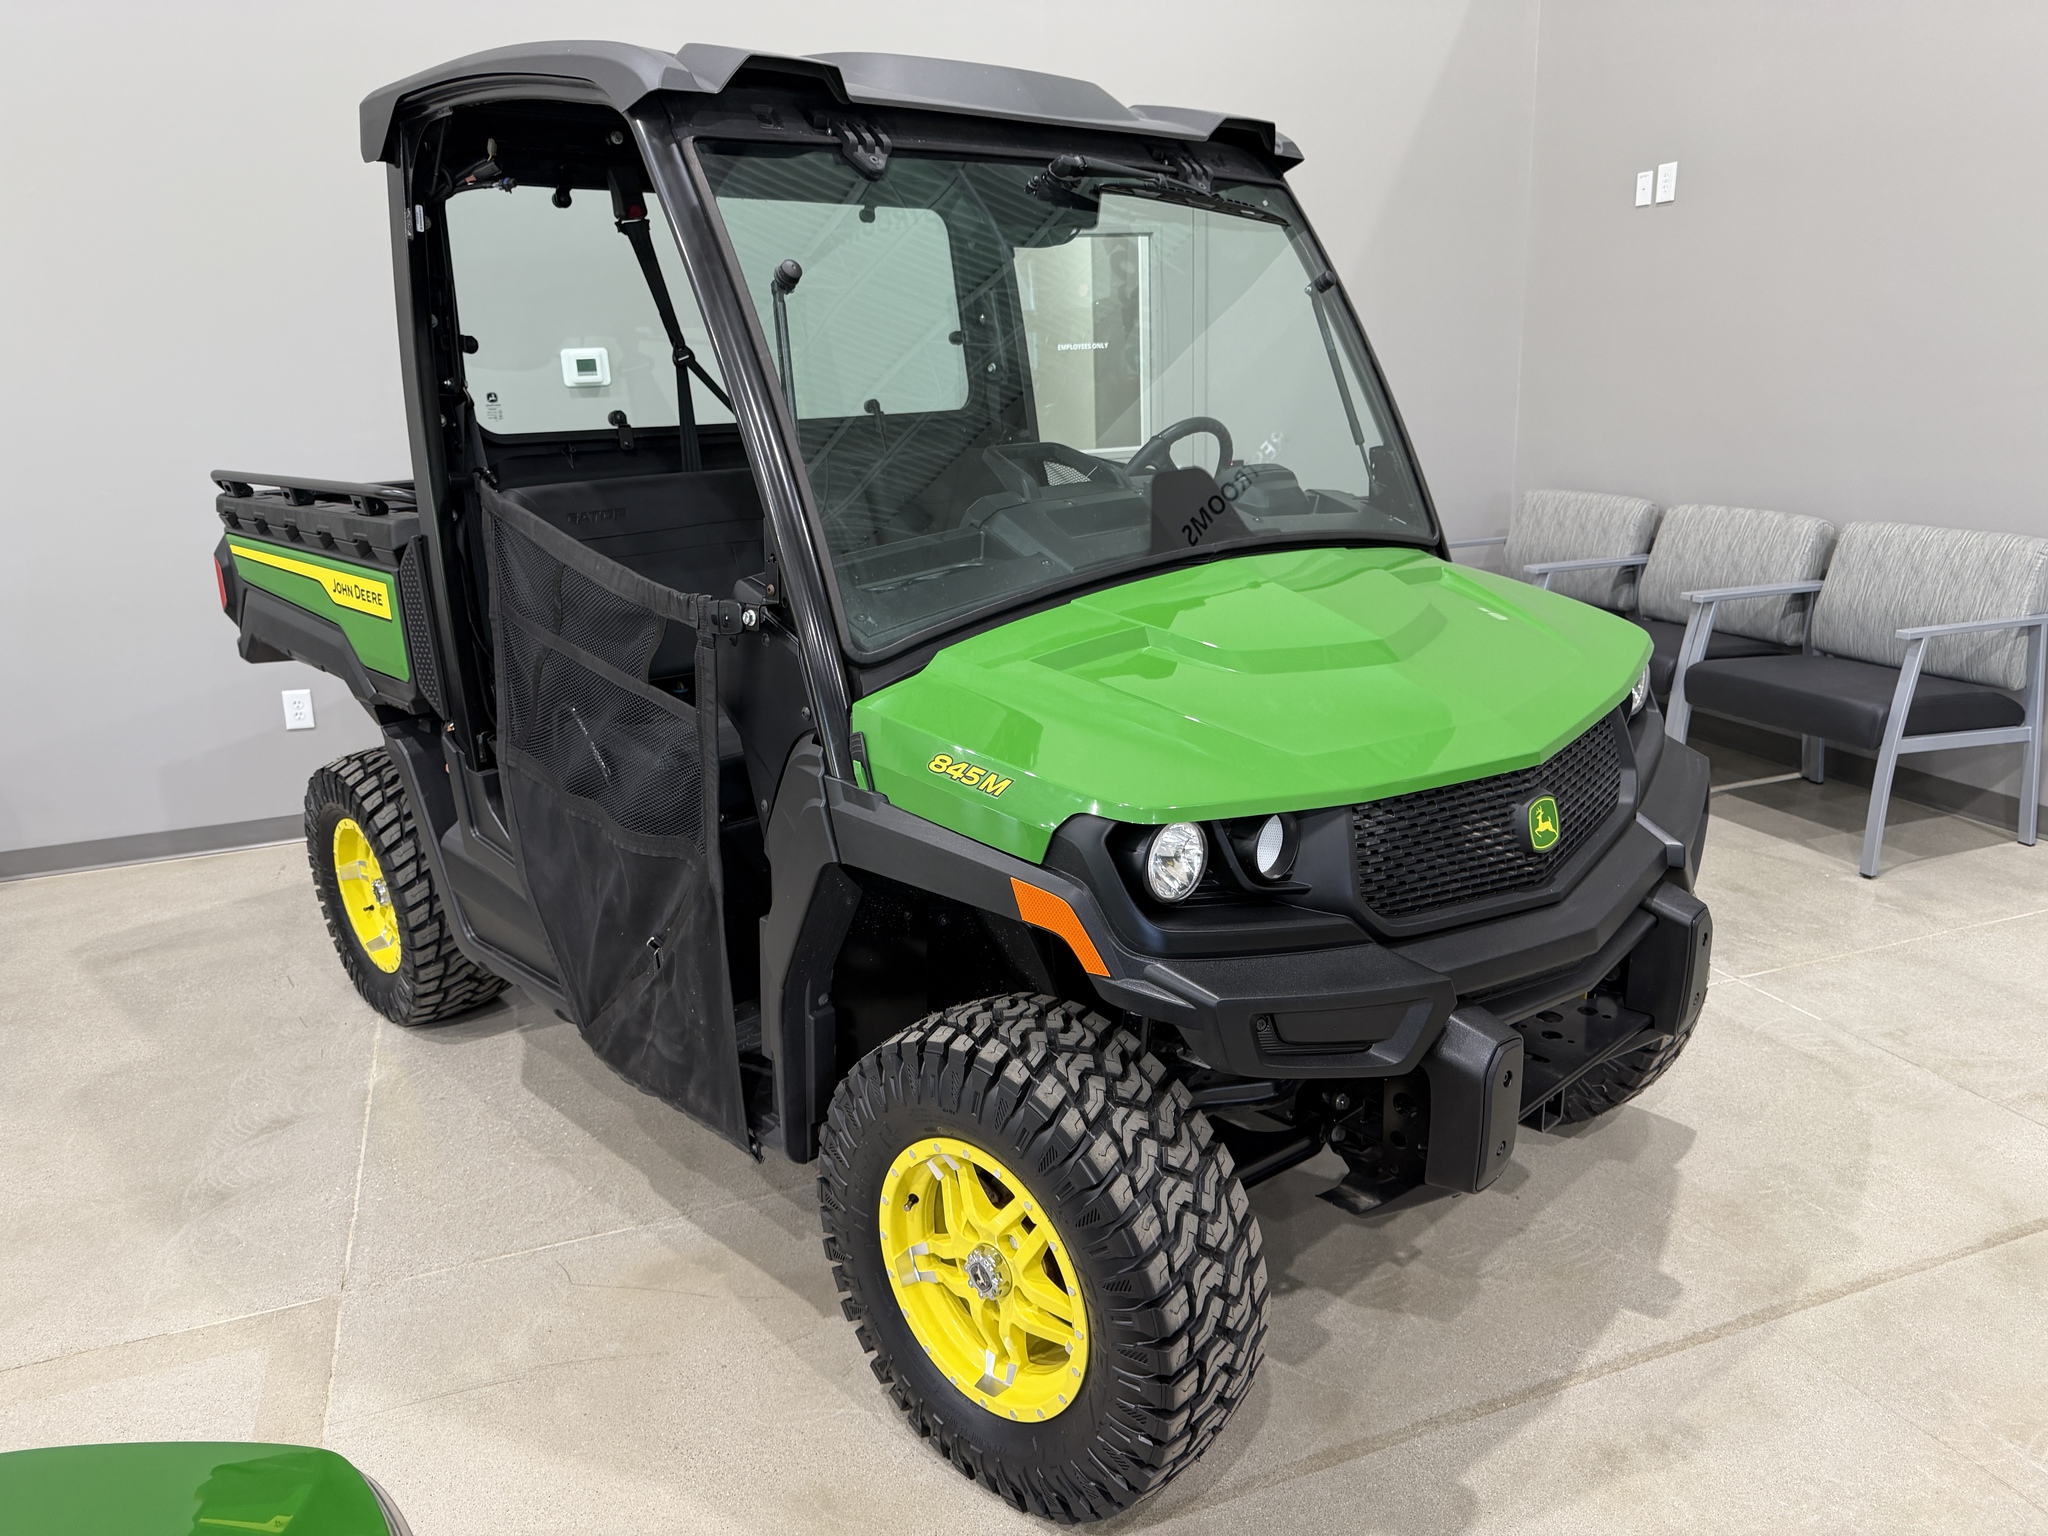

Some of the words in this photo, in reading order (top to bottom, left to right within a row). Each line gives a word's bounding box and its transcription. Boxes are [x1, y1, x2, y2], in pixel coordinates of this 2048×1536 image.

[1057, 343, 1091, 351] EMPLOYEES
[1092, 342, 1109, 350] ONLY
[332, 578, 353, 598] JOHN
[353, 585, 384, 607] DEERE
